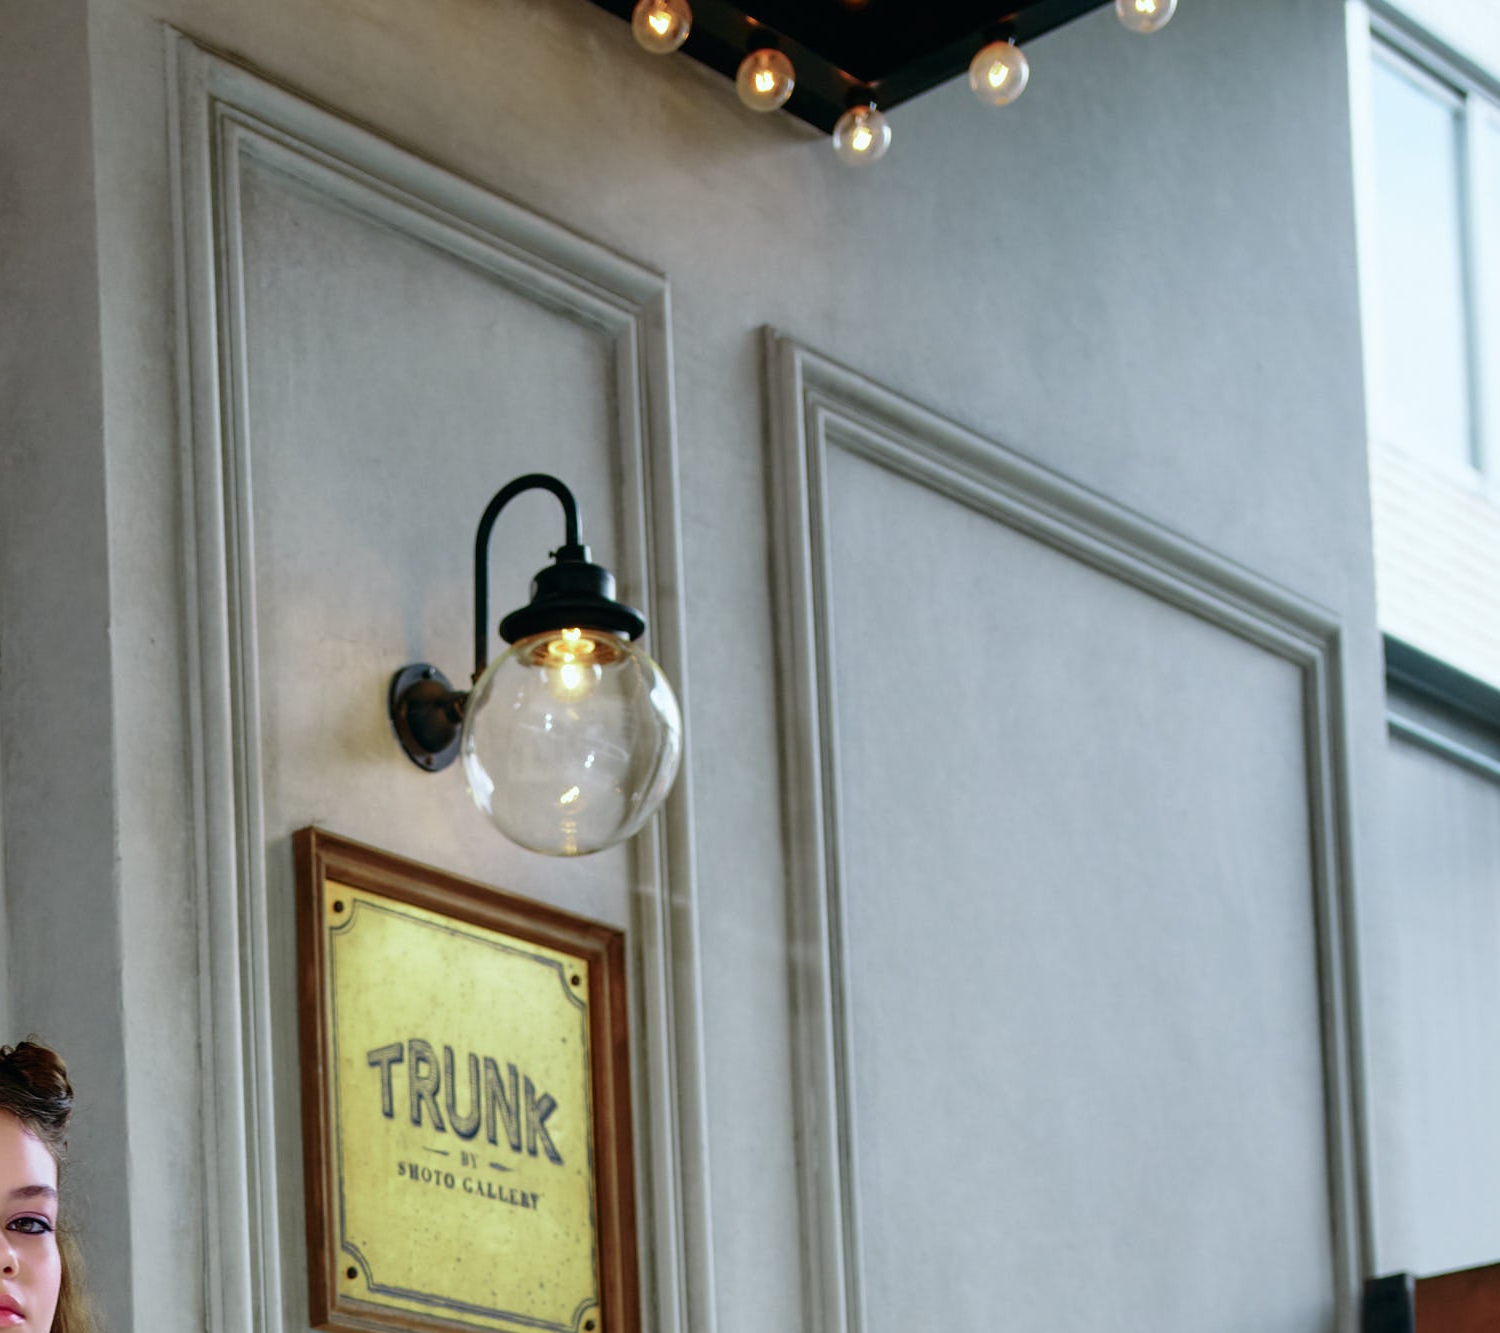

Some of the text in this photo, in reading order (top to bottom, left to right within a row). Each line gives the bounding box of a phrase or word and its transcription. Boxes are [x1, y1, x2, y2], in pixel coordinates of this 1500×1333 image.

[367, 1038, 564, 1166] TRUNK
[460, 1150, 478, 1169] BY
[398, 1161, 540, 1211] SHOTO GALLERY
